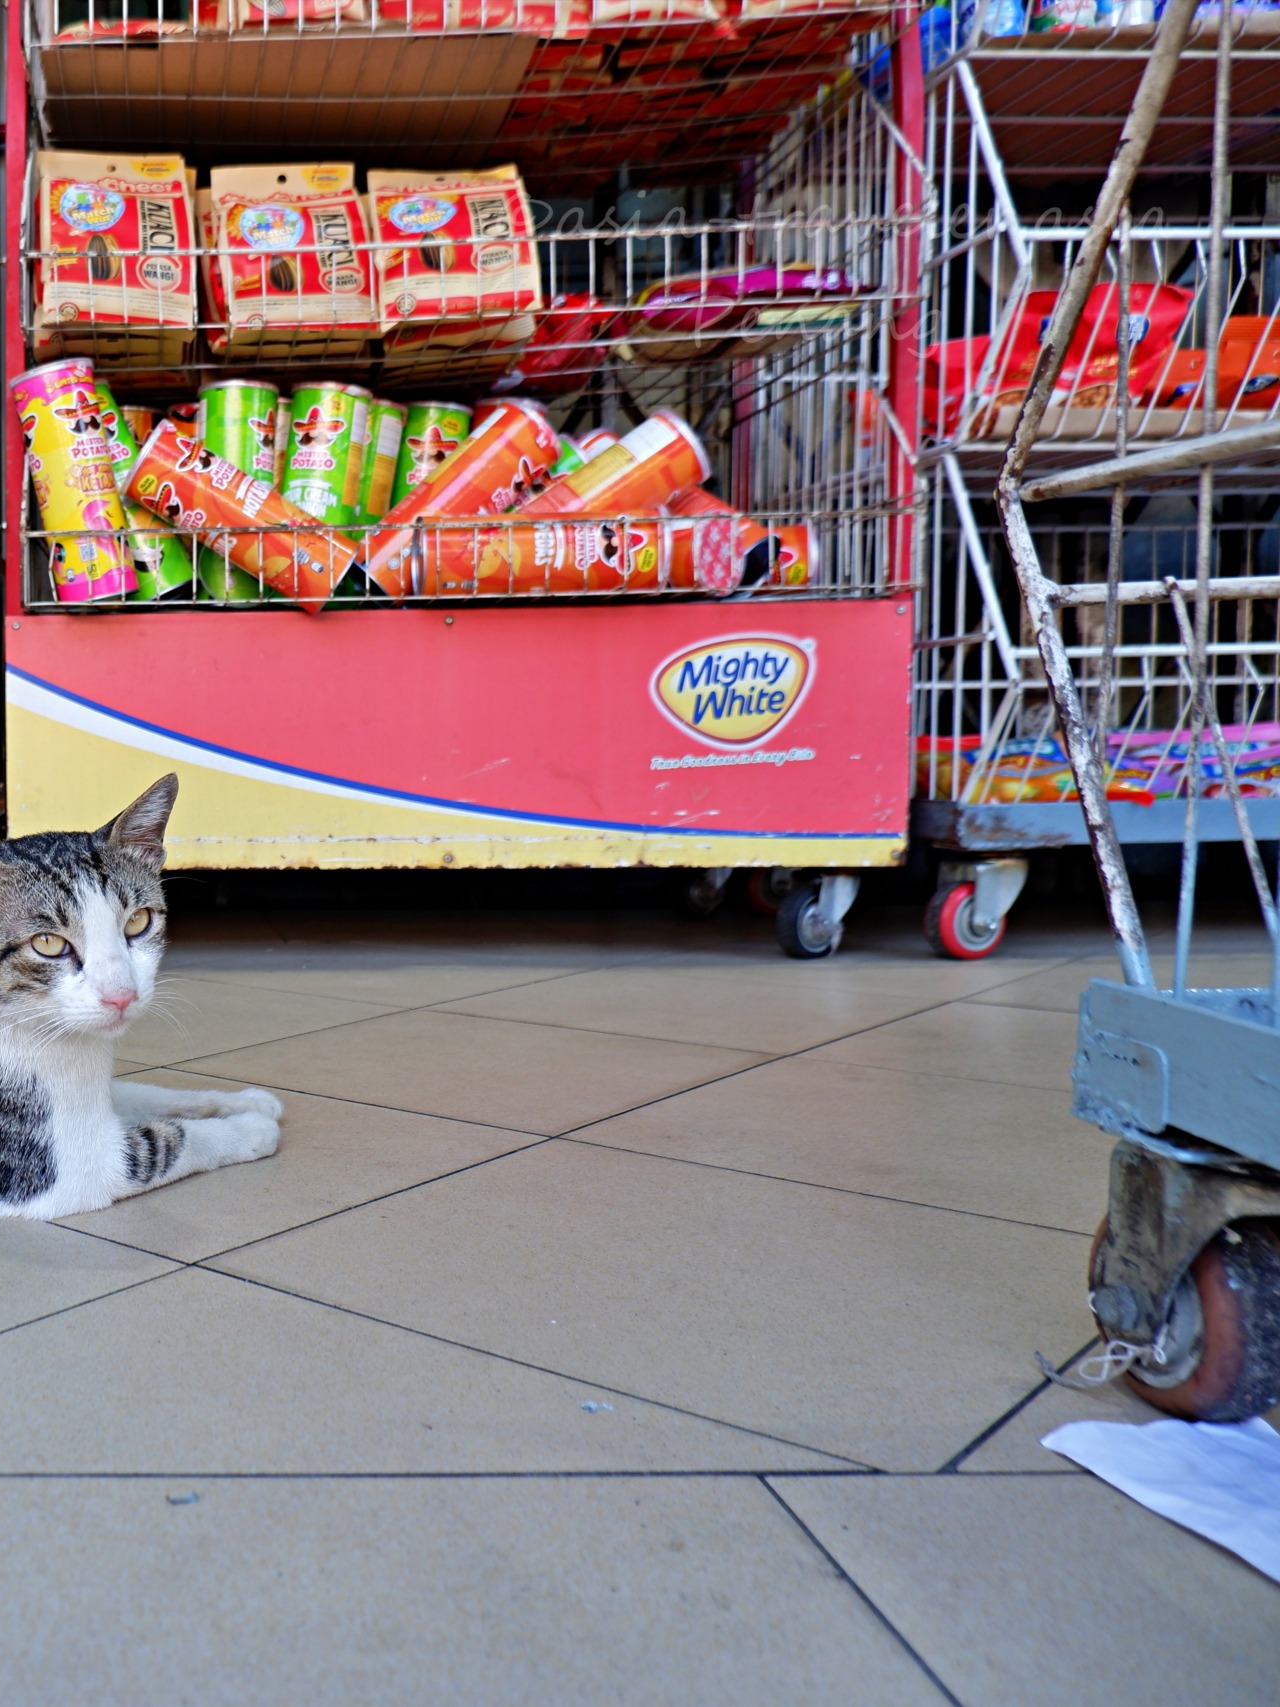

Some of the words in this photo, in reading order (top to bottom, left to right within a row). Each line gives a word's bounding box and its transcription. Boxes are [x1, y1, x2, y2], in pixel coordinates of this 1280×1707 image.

[146, 200, 176, 251] KUACI
[321, 213, 356, 268] KUACI
[290, 458, 335, 470] POTATO
[677, 650, 790, 694] Mighty
[692, 685, 786, 725] White
[650, 757, 680, 771] True
[680, 753, 737, 768] Goodness
[751, 750, 787, 767] Every
